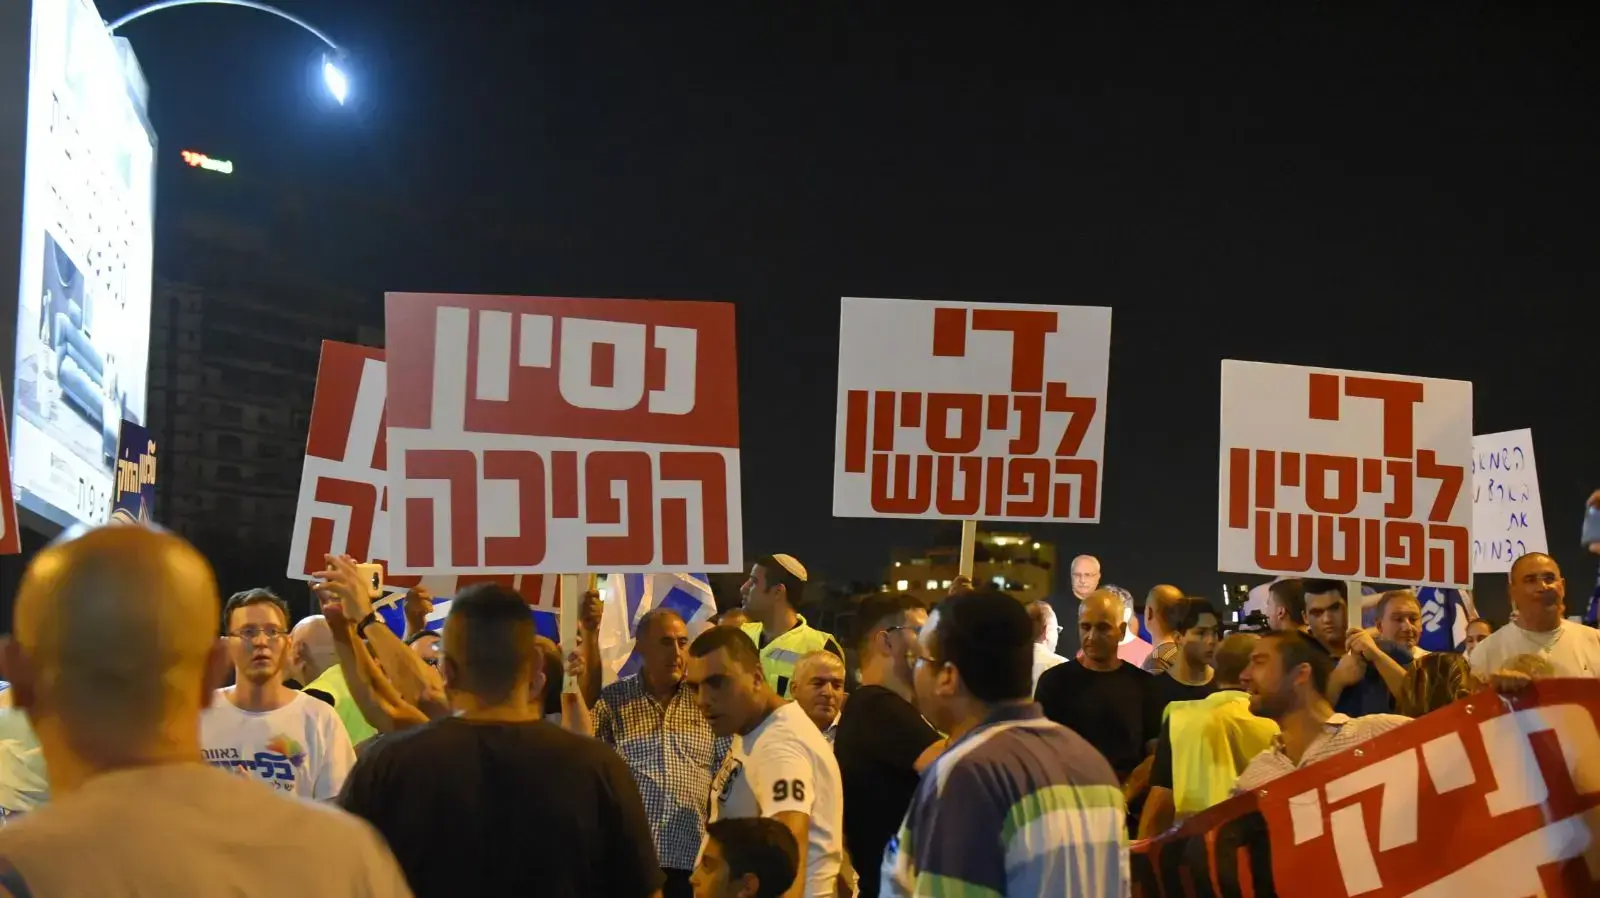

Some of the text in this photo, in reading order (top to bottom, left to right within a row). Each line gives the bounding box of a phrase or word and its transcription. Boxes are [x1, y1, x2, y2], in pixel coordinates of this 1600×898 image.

[430, 306, 697, 431] נסיון
[932, 307, 1058, 393] די
[844, 381, 1097, 473] לניסיון
[1308, 372, 1424, 459] די
[405, 448, 729, 568] הפיכה
[870, 453, 1098, 519] הפוטש
[1228, 447, 1465, 529] לניסיון
[1507, 511, 1529, 531] את
[1254, 506, 1469, 585] הפוטש
[772, 778, 806, 802] 96
